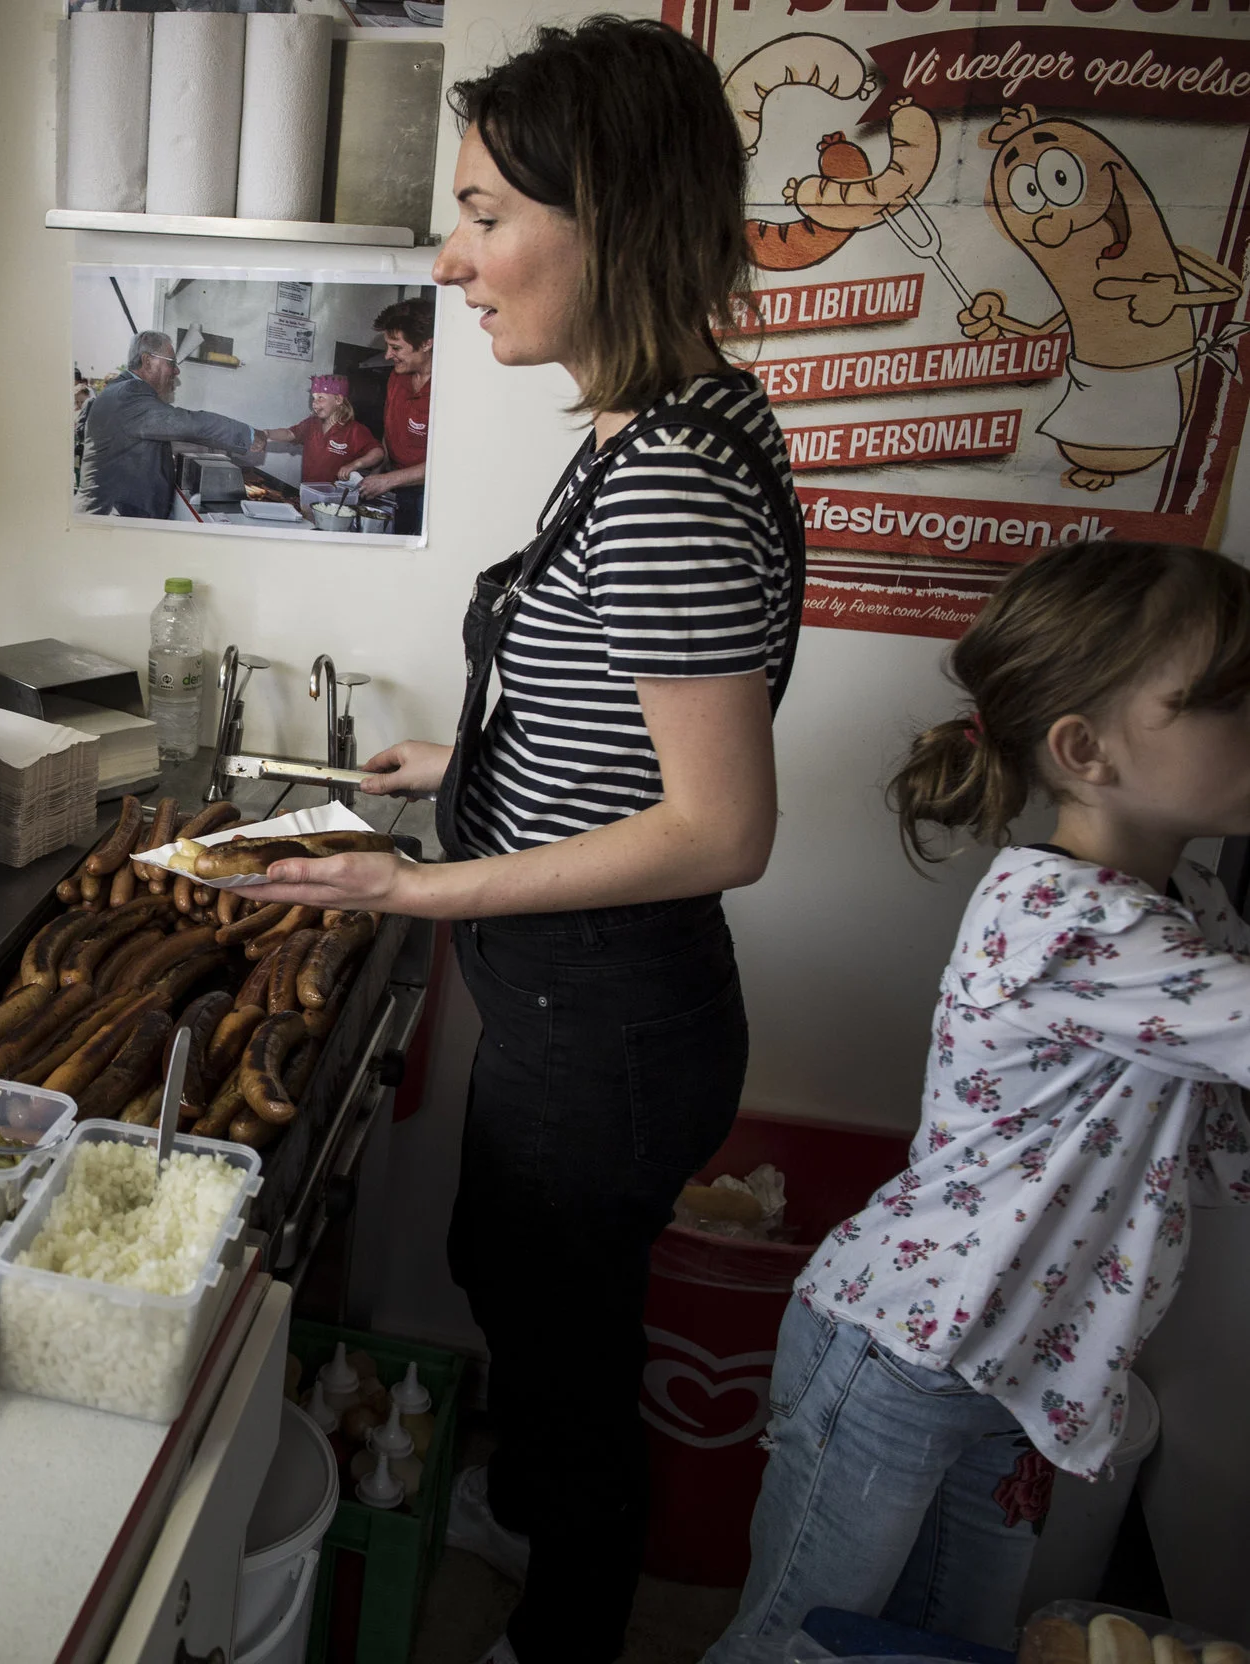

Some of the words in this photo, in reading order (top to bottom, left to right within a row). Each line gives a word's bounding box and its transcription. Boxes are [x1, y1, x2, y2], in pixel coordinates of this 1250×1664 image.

[902, 47, 941, 89] Vi
[946, 40, 1075, 98] sælger
[755, 293, 792, 327] AD
[798, 280, 918, 322] LIBITUM!
[821, 337, 1059, 391] UFORGLEMMELIG!
[784, 429, 844, 463] NDE
[849, 414, 1015, 459] PERSONALE!
[800, 497, 1115, 551] .festvognen.dk
[830, 596, 846, 617] by
